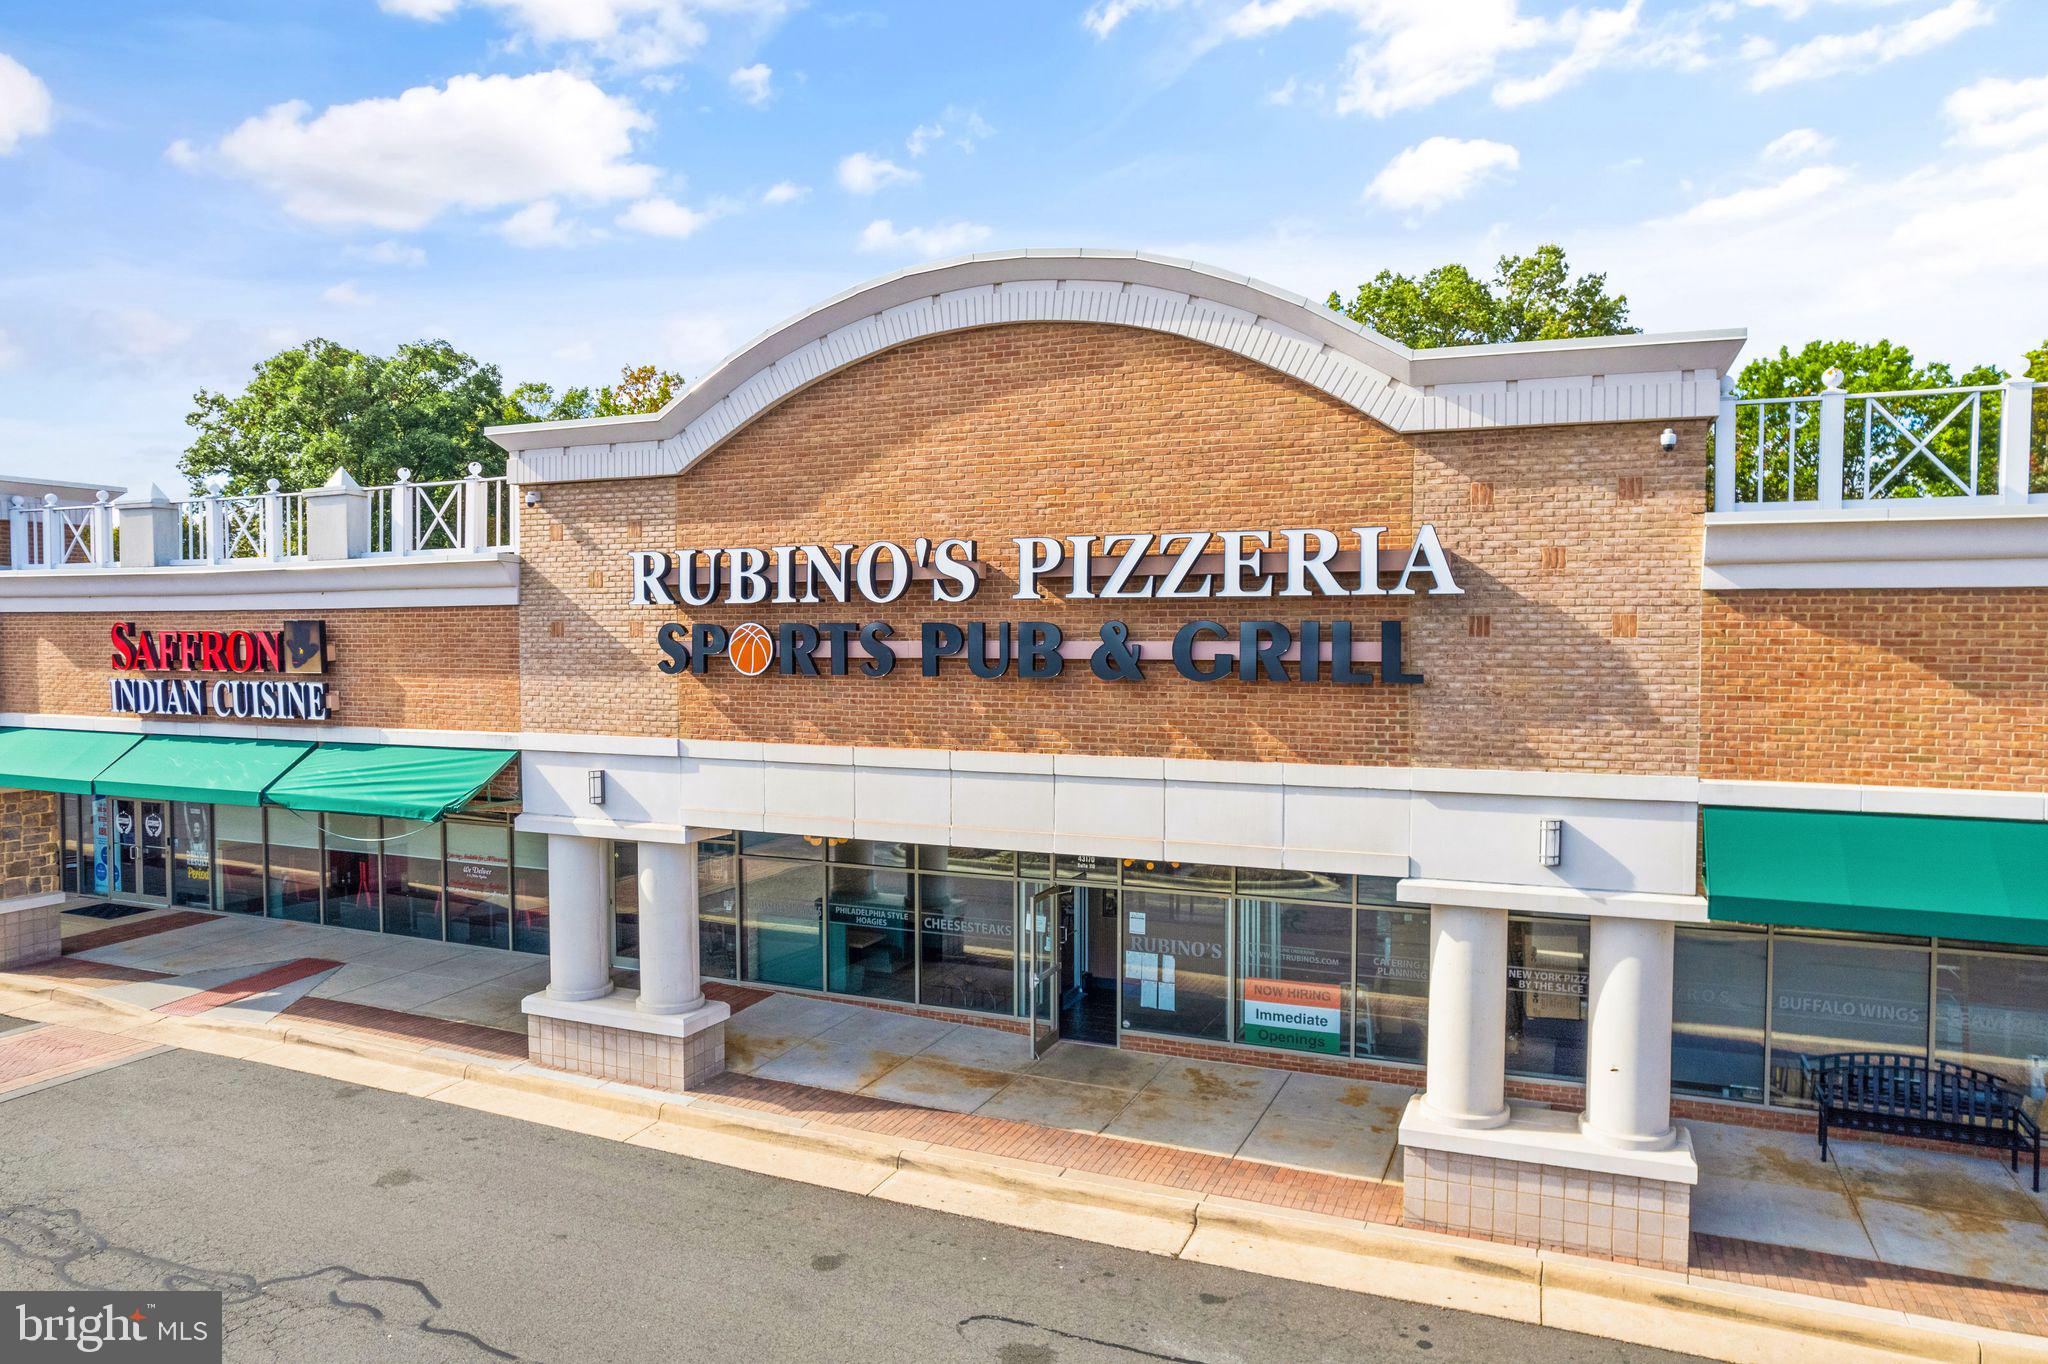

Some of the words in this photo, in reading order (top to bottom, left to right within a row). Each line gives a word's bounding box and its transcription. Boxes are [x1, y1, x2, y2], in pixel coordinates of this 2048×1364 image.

[627, 537, 981, 606] RUBINO'S
[1012, 524, 1466, 599] PIZZERIA
[111, 621, 282, 673] SAFFRON
[921, 621, 1063, 678] PUB
[1090, 620, 1146, 682] &
[1172, 620, 1425, 684] GRILL
[109, 677, 205, 716] INDIAN
[212, 679, 329, 720] CUISINE
[835, 906, 886, 918] PHILADELPHIA
[887, 911, 909, 921] STYLE
[856, 917, 888, 927] HOAGIES
[924, 917, 1012, 936] CHEESESTEAKS
[1130, 935, 1223, 959] RUBINO'S
[1373, 957, 1422, 970] CATERING
[1377, 967, 1428, 979] PLANNING
[1508, 969, 1532, 979] NEW
[1534, 971, 1561, 982] YORK
[1564, 974, 1589, 984] PIZZ
[1254, 984, 1284, 998] NOW
[1287, 988, 1331, 1001] HIRING
[1518, 980, 1531, 989] BY
[1533, 981, 1553, 991] THE
[1555, 983, 1584, 994] SLICE
[1256, 1008, 1328, 1027] Immediate
[1779, 996, 1856, 1016] BUFFALO
[1860, 1003, 1919, 1022] WINGS
[1258, 1029, 1325, 1049] Openings
